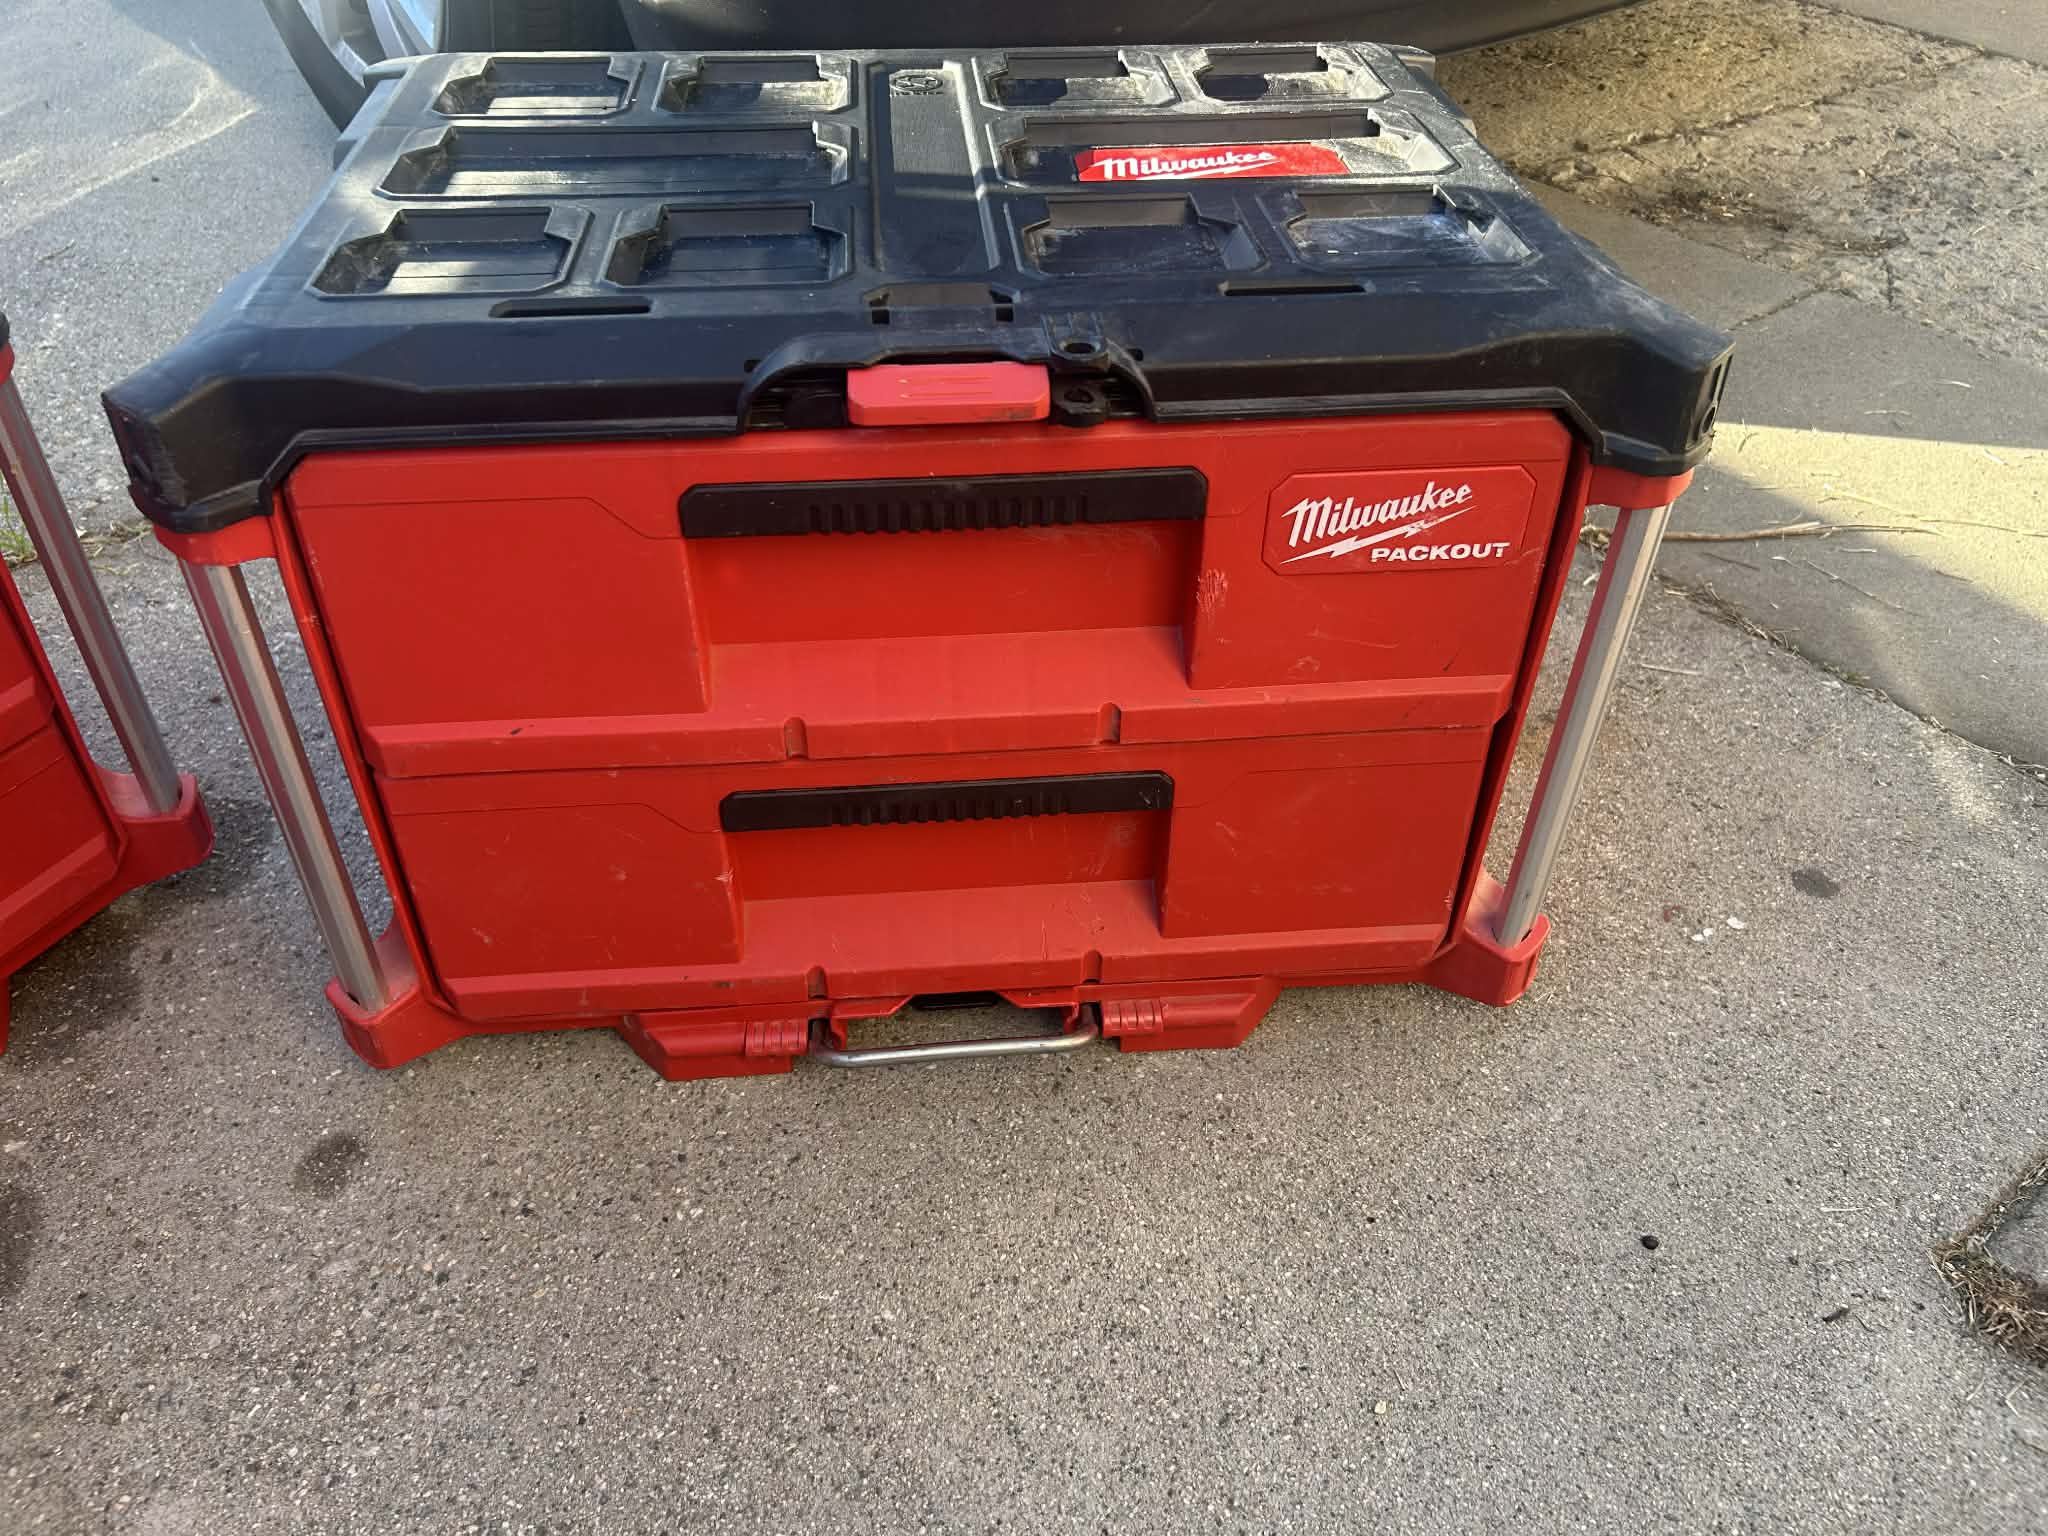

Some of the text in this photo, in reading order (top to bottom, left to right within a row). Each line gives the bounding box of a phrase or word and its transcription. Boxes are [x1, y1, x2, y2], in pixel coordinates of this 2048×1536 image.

[1090, 151, 1278, 179] Milwaukee
[1281, 481, 1473, 548] Milwaukee
[1371, 542, 1511, 562] PACKOUT
